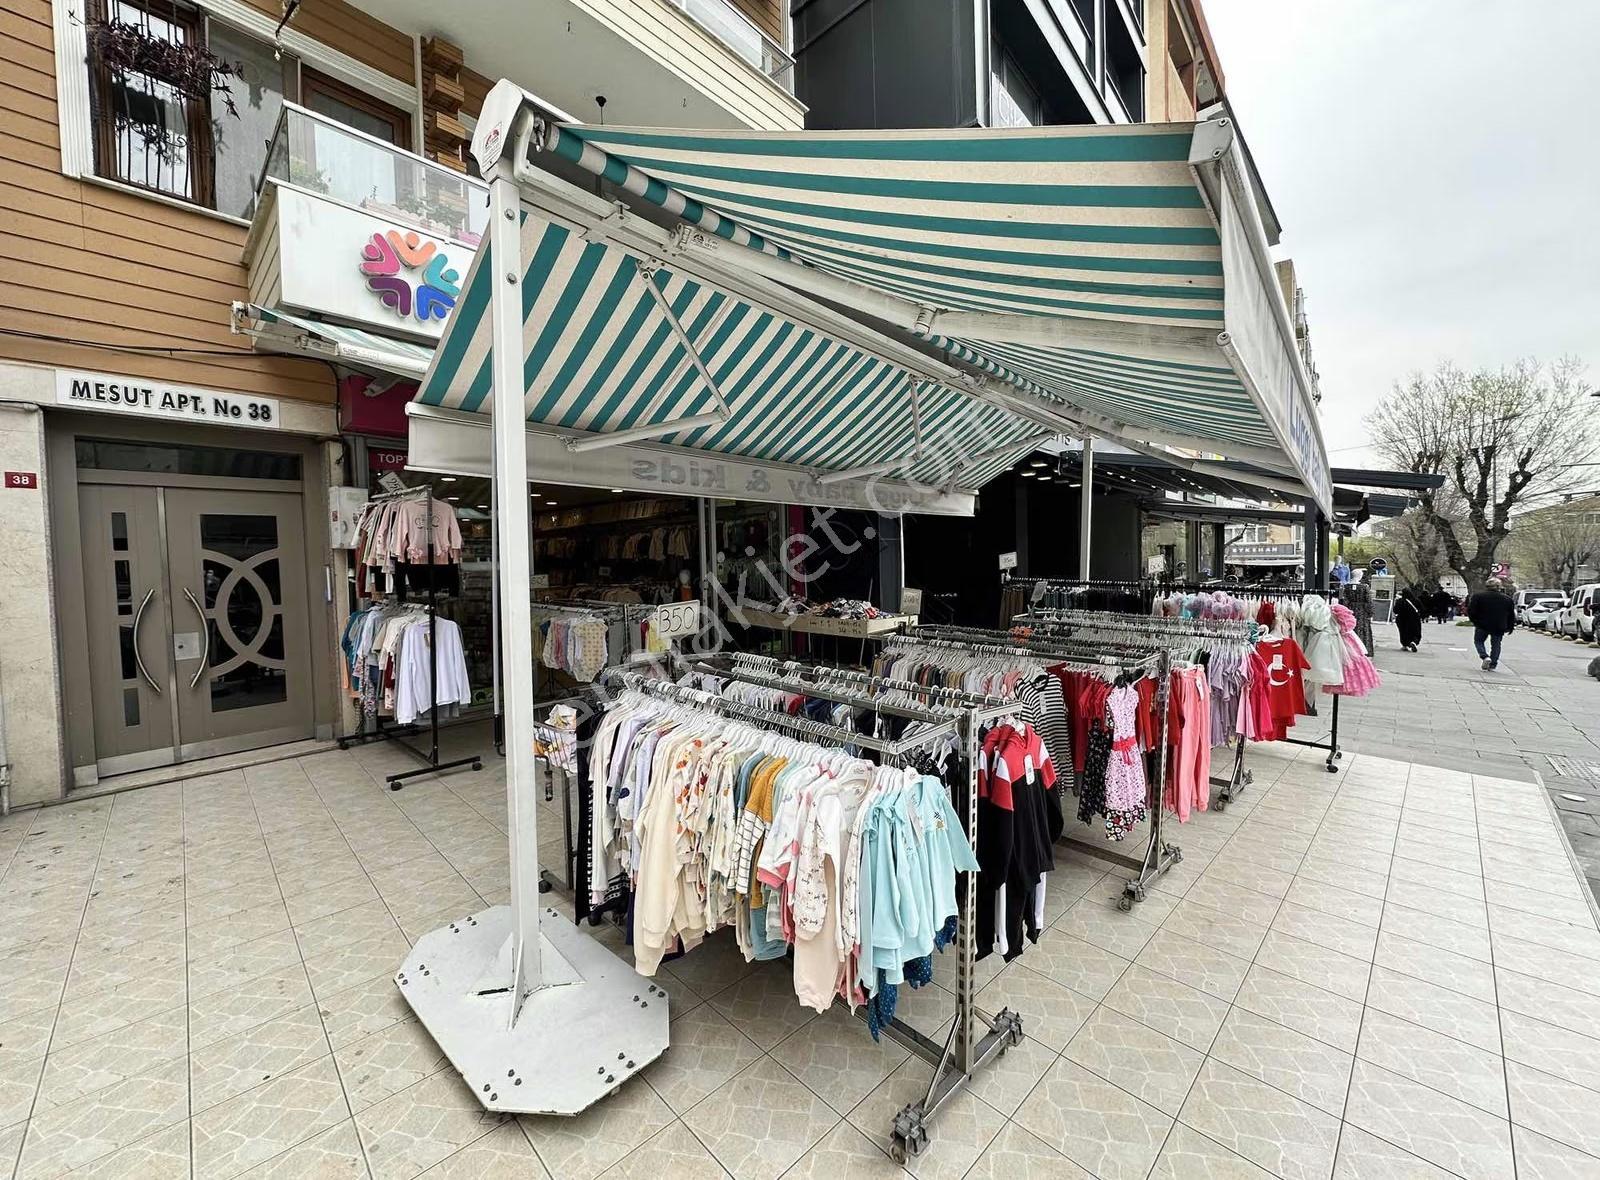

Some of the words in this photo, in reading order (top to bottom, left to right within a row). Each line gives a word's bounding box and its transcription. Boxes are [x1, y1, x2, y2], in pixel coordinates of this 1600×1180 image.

[70, 379, 152, 406] MESUT
[160, 392, 206, 413] APT.
[213, 399, 241, 417] No
[248, 404, 272, 421] 38
[12, 475, 30, 485] 38
[660, 606, 695, 632] 350
